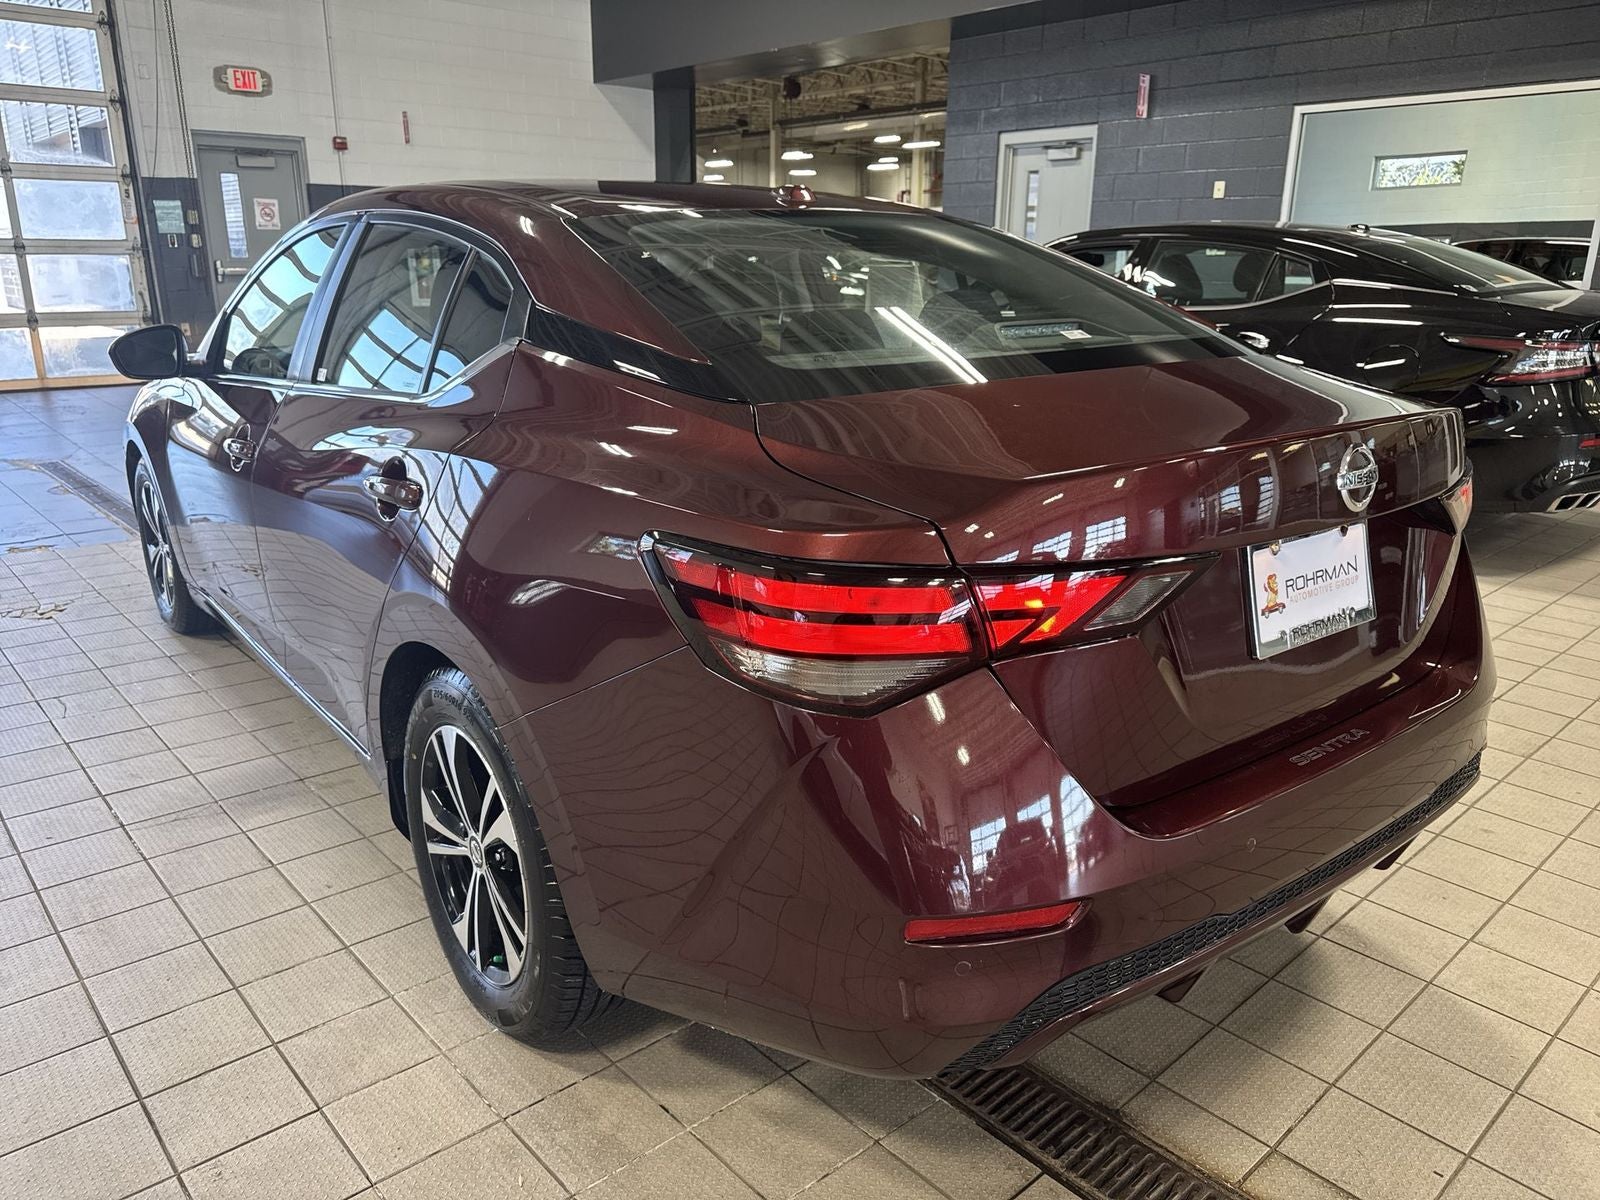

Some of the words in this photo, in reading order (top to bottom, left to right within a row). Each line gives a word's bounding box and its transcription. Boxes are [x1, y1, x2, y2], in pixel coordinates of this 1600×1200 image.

[233, 69, 257, 90] EXIT
[124, 188, 131, 199] 5
[1285, 555, 1358, 599] ROHRMAN
[1289, 583, 1333, 604] AUTOMOTIVE
[1336, 574, 1360, 591] GROUP
[1291, 607, 1347, 641] ROHRMAN
[1288, 727, 1371, 767] SENTRA
